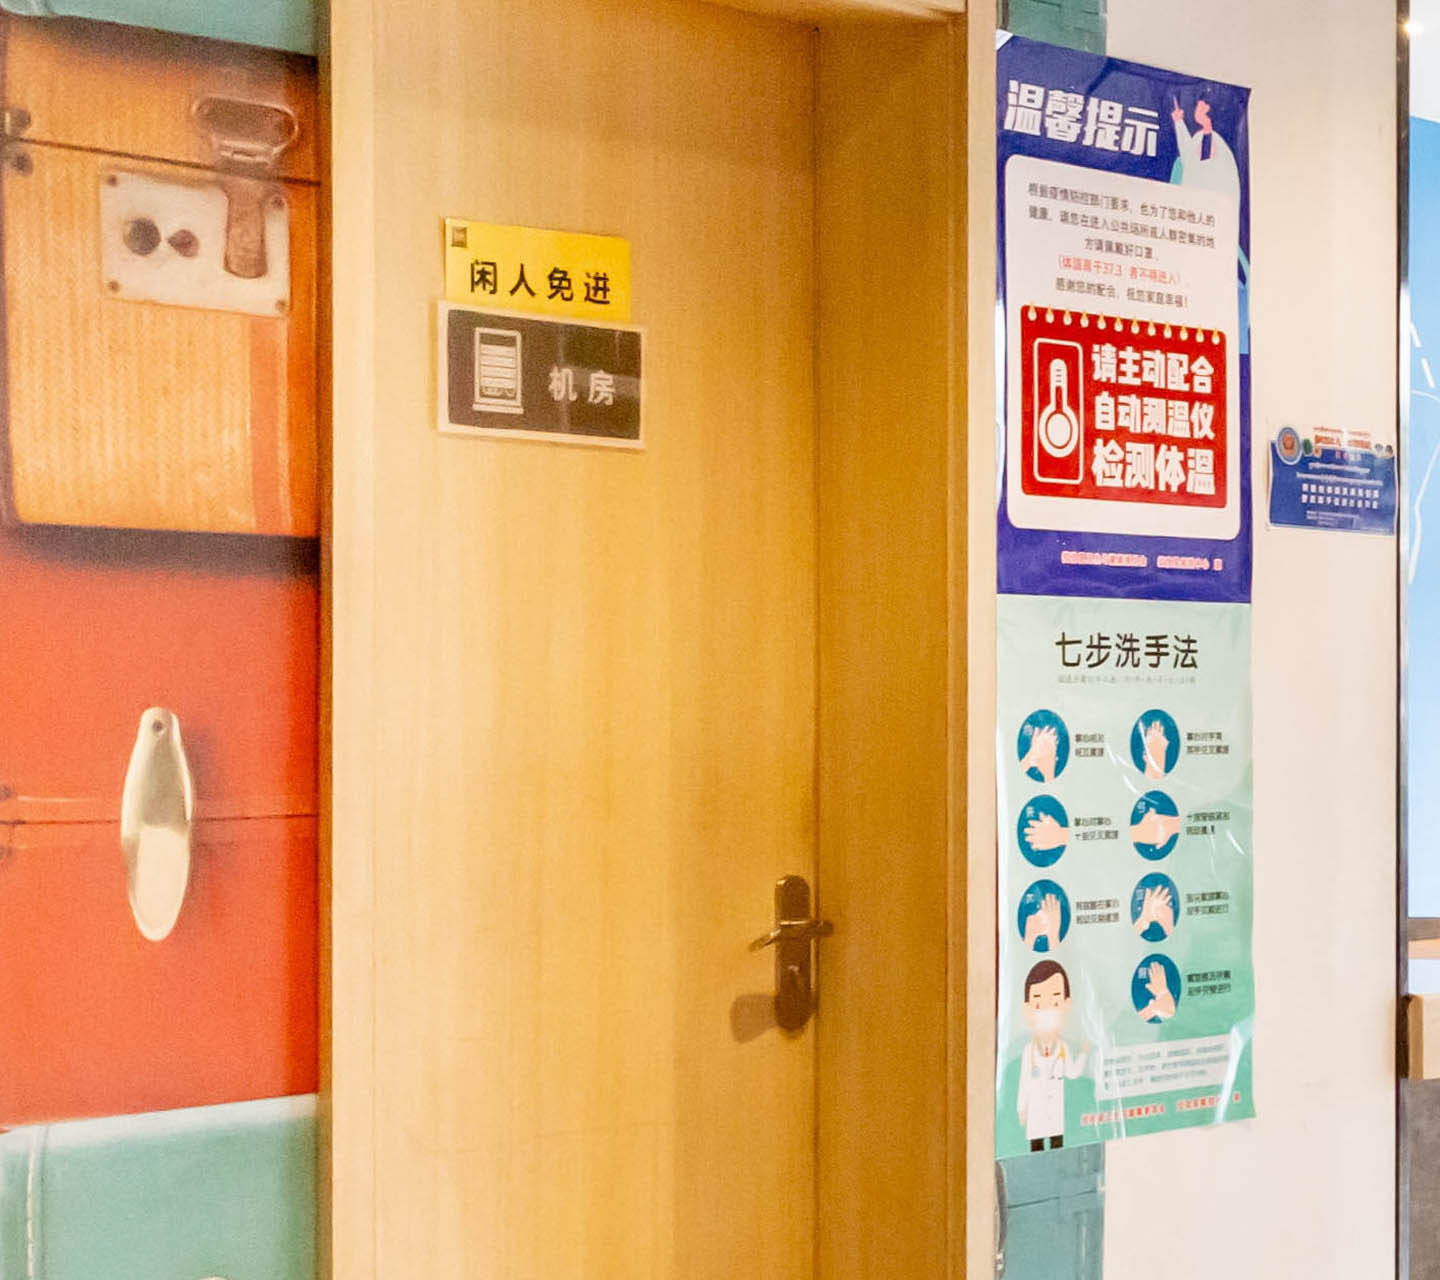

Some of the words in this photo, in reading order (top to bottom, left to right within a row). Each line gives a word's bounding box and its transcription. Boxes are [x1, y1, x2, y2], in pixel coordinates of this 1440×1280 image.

[1003, 79, 1161, 160] 温馨提示
[470, 258, 611, 306] 闲人免进
[549, 366, 616, 407] 机房
[1090, 342, 1215, 396] 请主动配合
[1092, 394, 1217, 442] 自动测温仪
[1090, 442, 1216, 497] 检测体温
[1055, 631, 1199, 670] 七步洗手法
